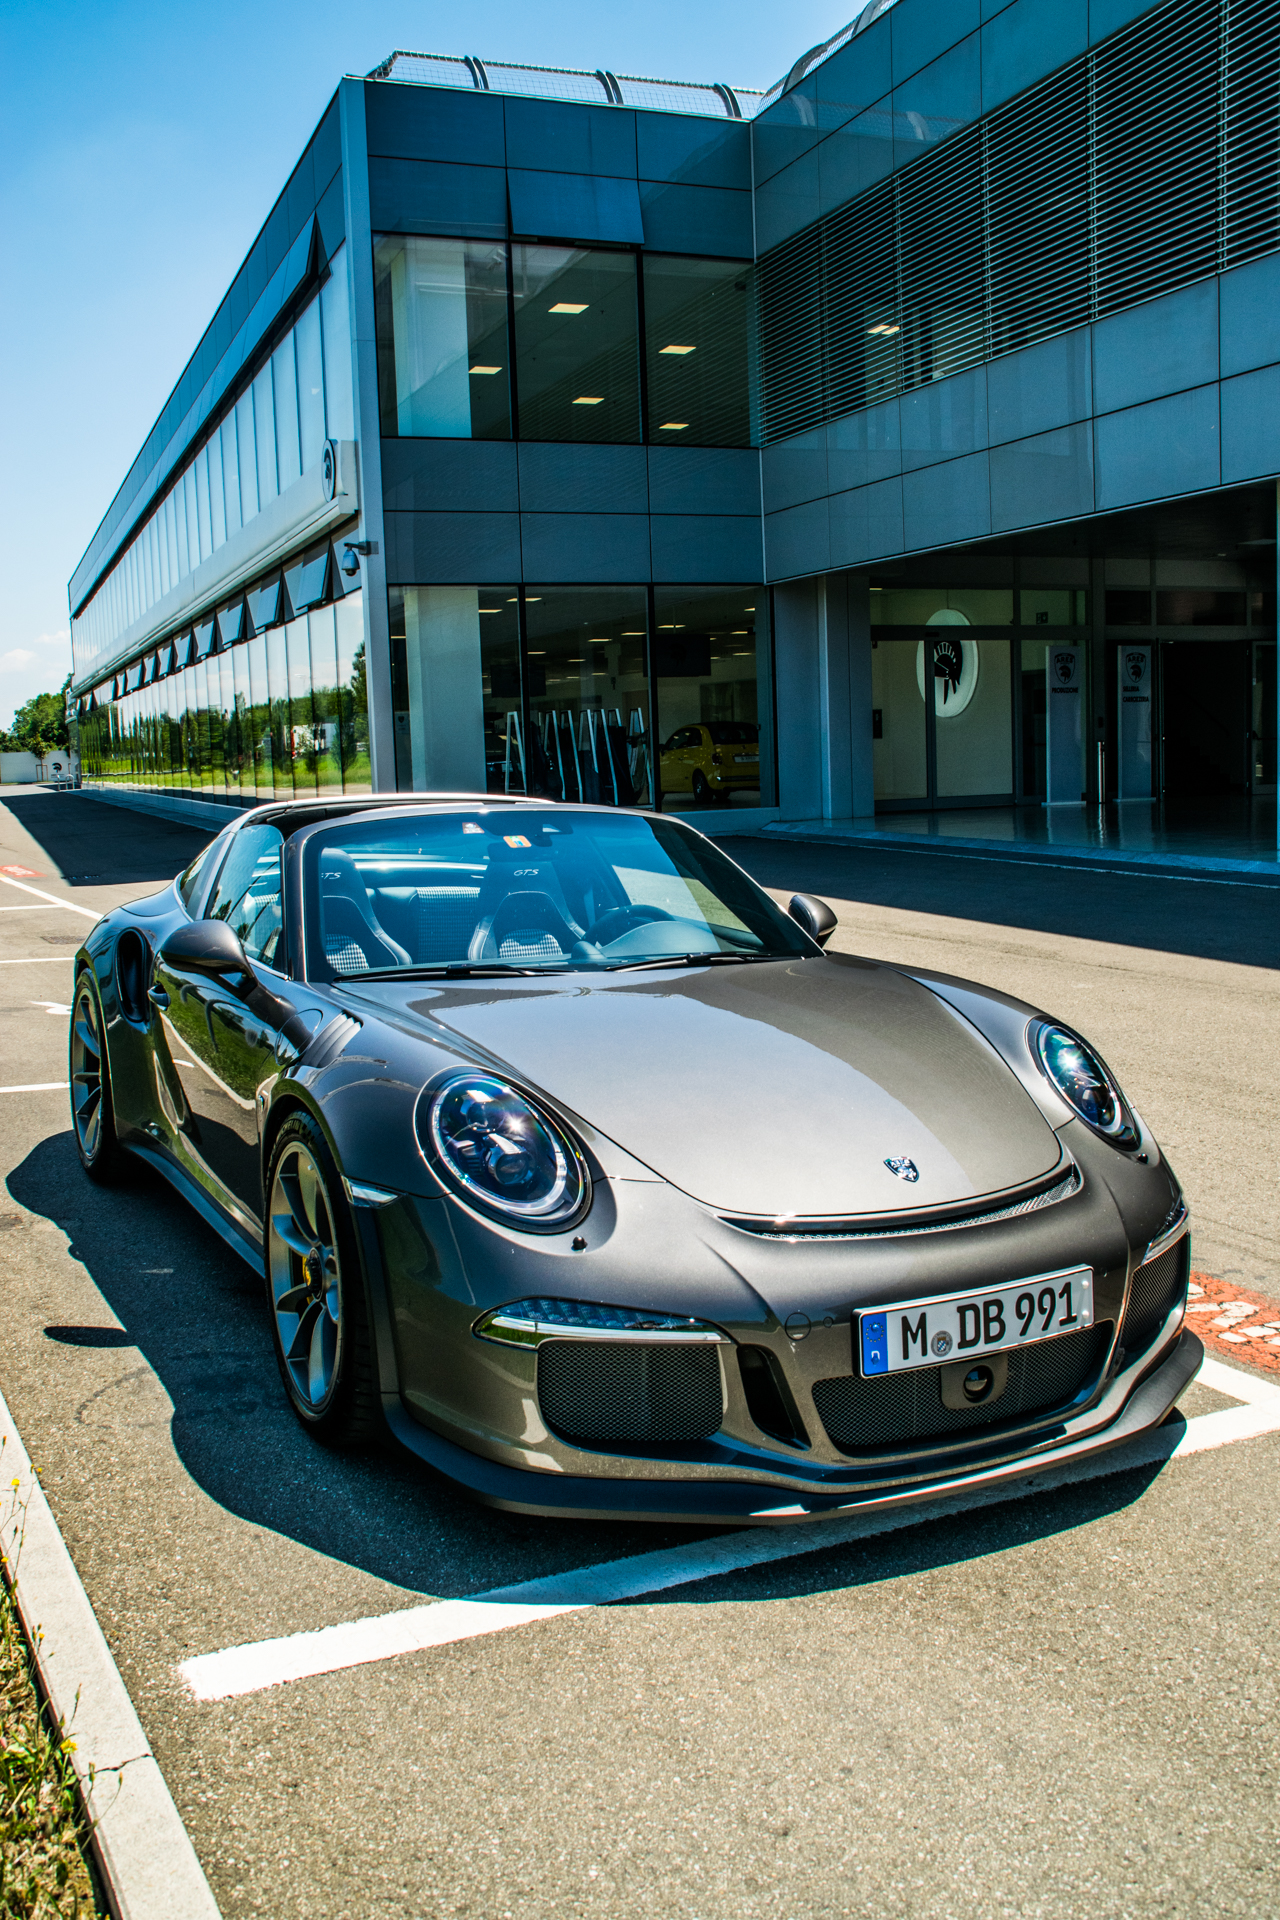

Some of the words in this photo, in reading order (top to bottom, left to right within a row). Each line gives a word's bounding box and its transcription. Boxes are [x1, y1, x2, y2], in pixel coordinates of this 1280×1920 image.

[513, 868, 540, 878] GTS
[901, 1312, 928, 1361] M
[956, 1299, 1006, 1351] DB
[1015, 1282, 1078, 1338] 991
